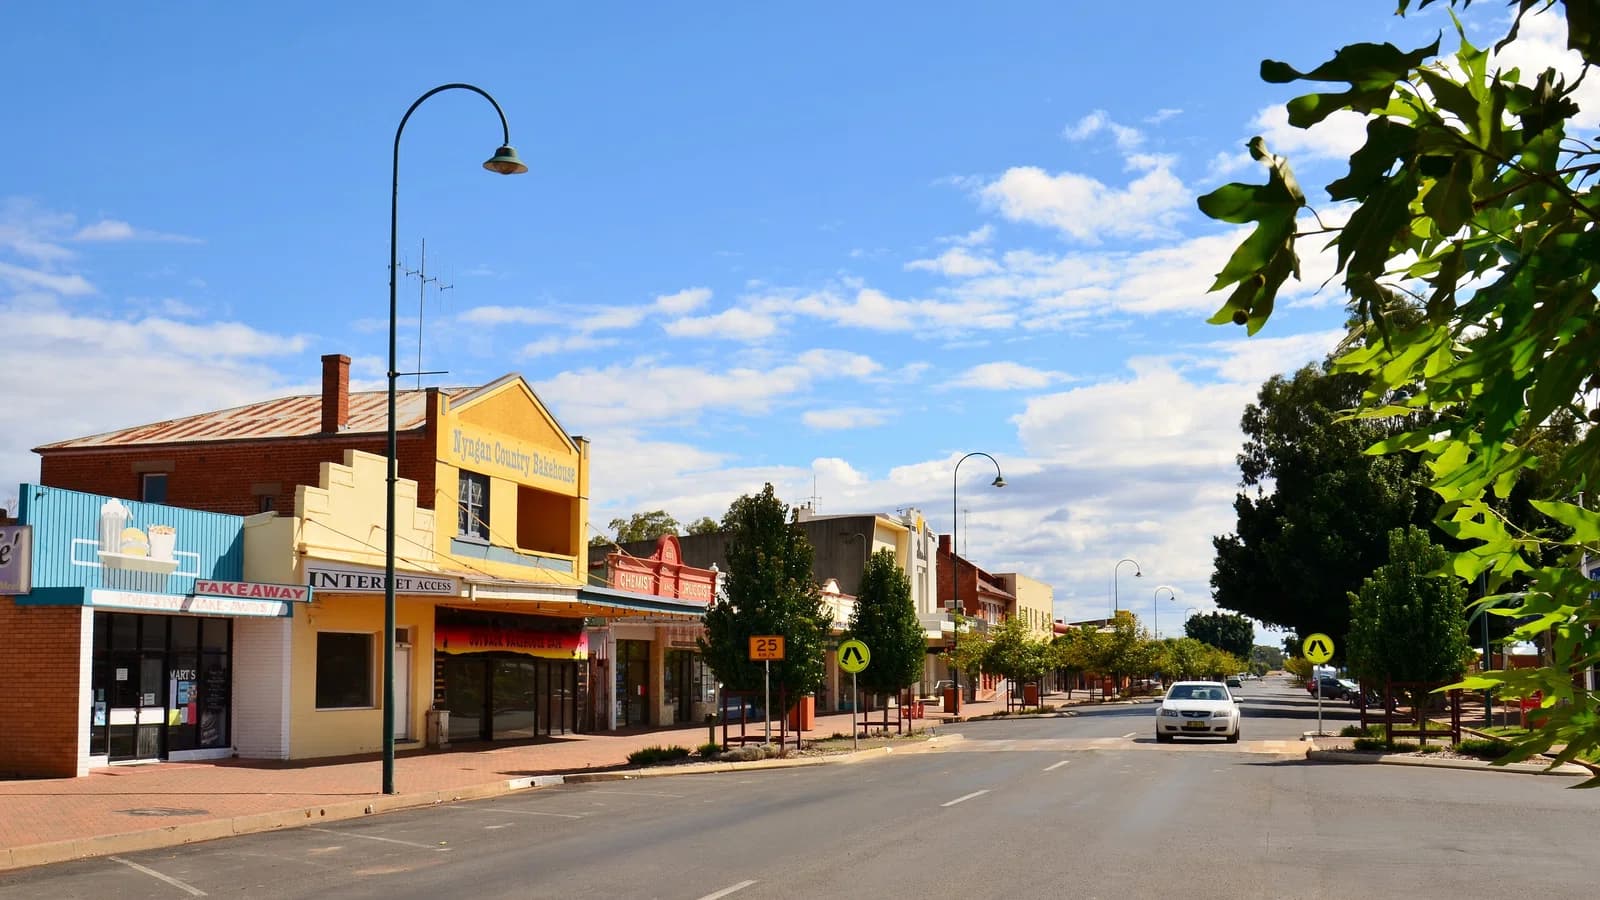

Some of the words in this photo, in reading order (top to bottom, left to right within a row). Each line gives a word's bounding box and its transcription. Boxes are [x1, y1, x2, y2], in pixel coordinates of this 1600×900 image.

[453, 429, 492, 464] Nyngan
[494, 441, 530, 477] Country
[533, 452, 575, 484] Bakehouse
[308, 571, 412, 590] INTERET
[416, 579, 451, 591] ACCESS
[620, 573, 652, 590] CHEMIST
[197, 582, 305, 599] TAKEAWAY
[756, 639, 778, 652] 25
